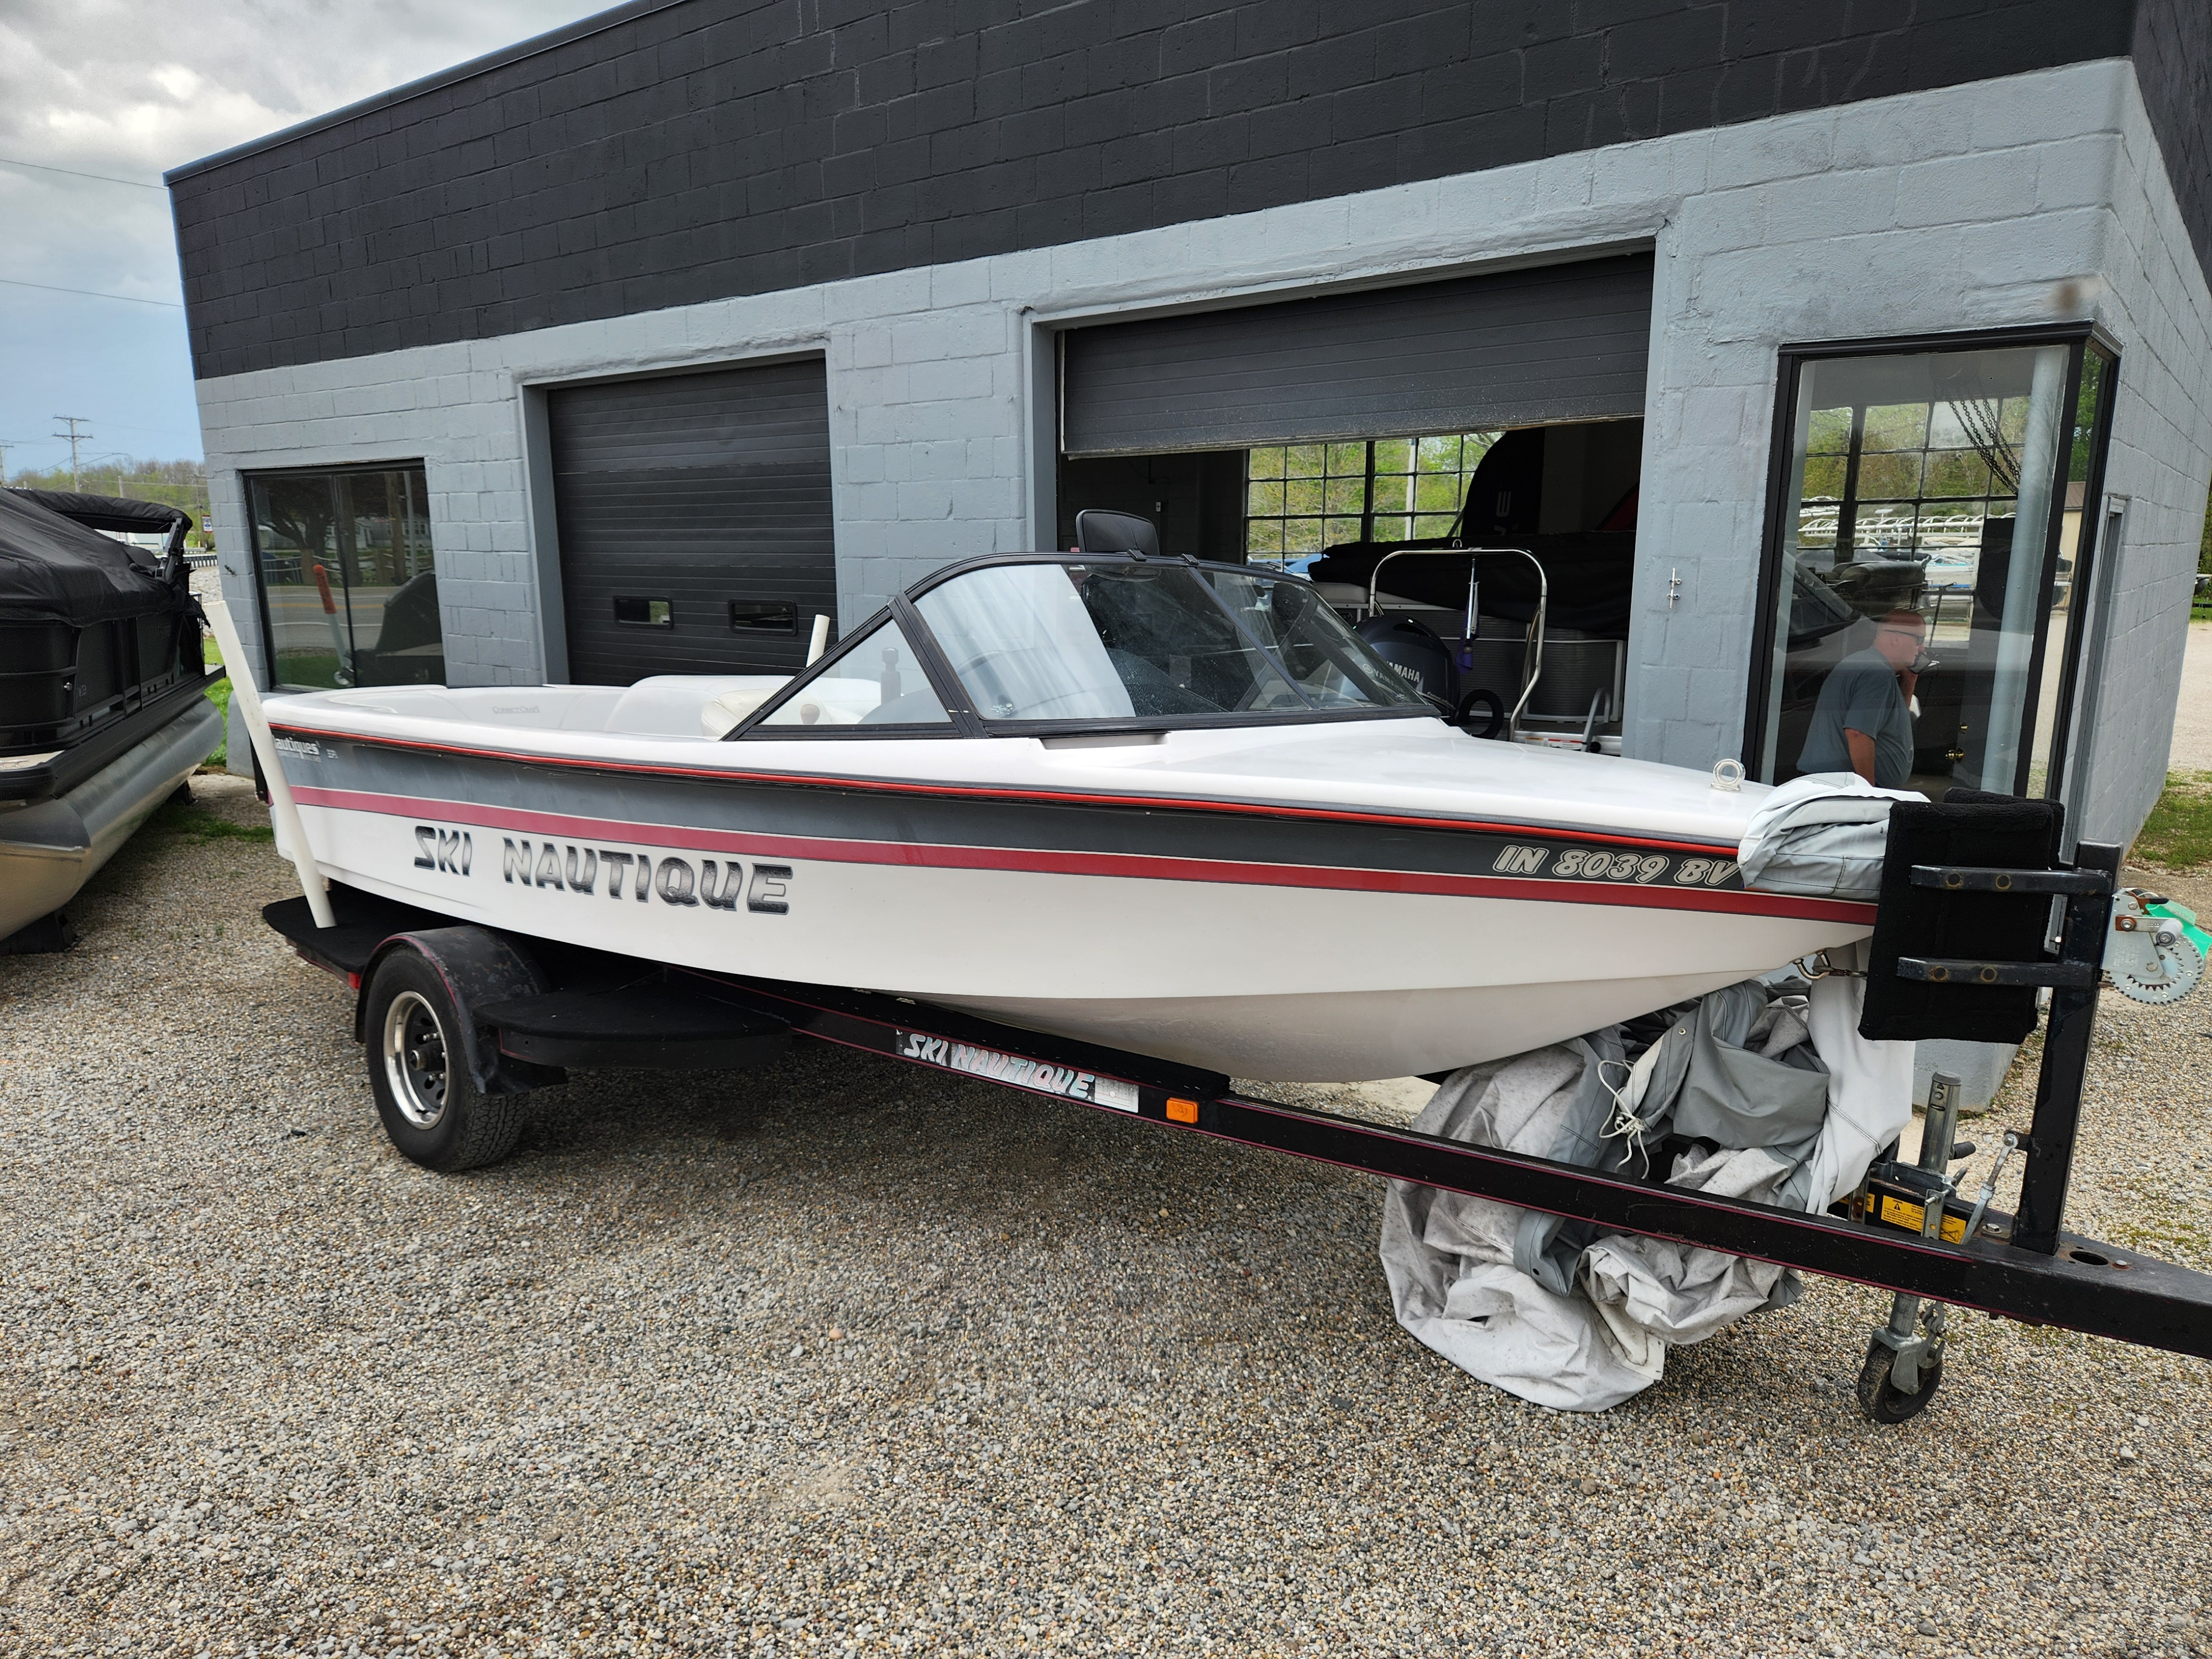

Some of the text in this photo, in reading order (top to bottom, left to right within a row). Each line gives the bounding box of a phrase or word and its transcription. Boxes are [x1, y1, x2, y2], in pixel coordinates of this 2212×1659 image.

[1387, 662, 1420, 683] MAHA
[273, 737, 320, 759] autiques
[414, 826, 793, 915] SKI NAUTIQUE
[1493, 845, 1739, 886] IN 8039 BV
[904, 1034, 1095, 1099] SKI NAUTIQUE
